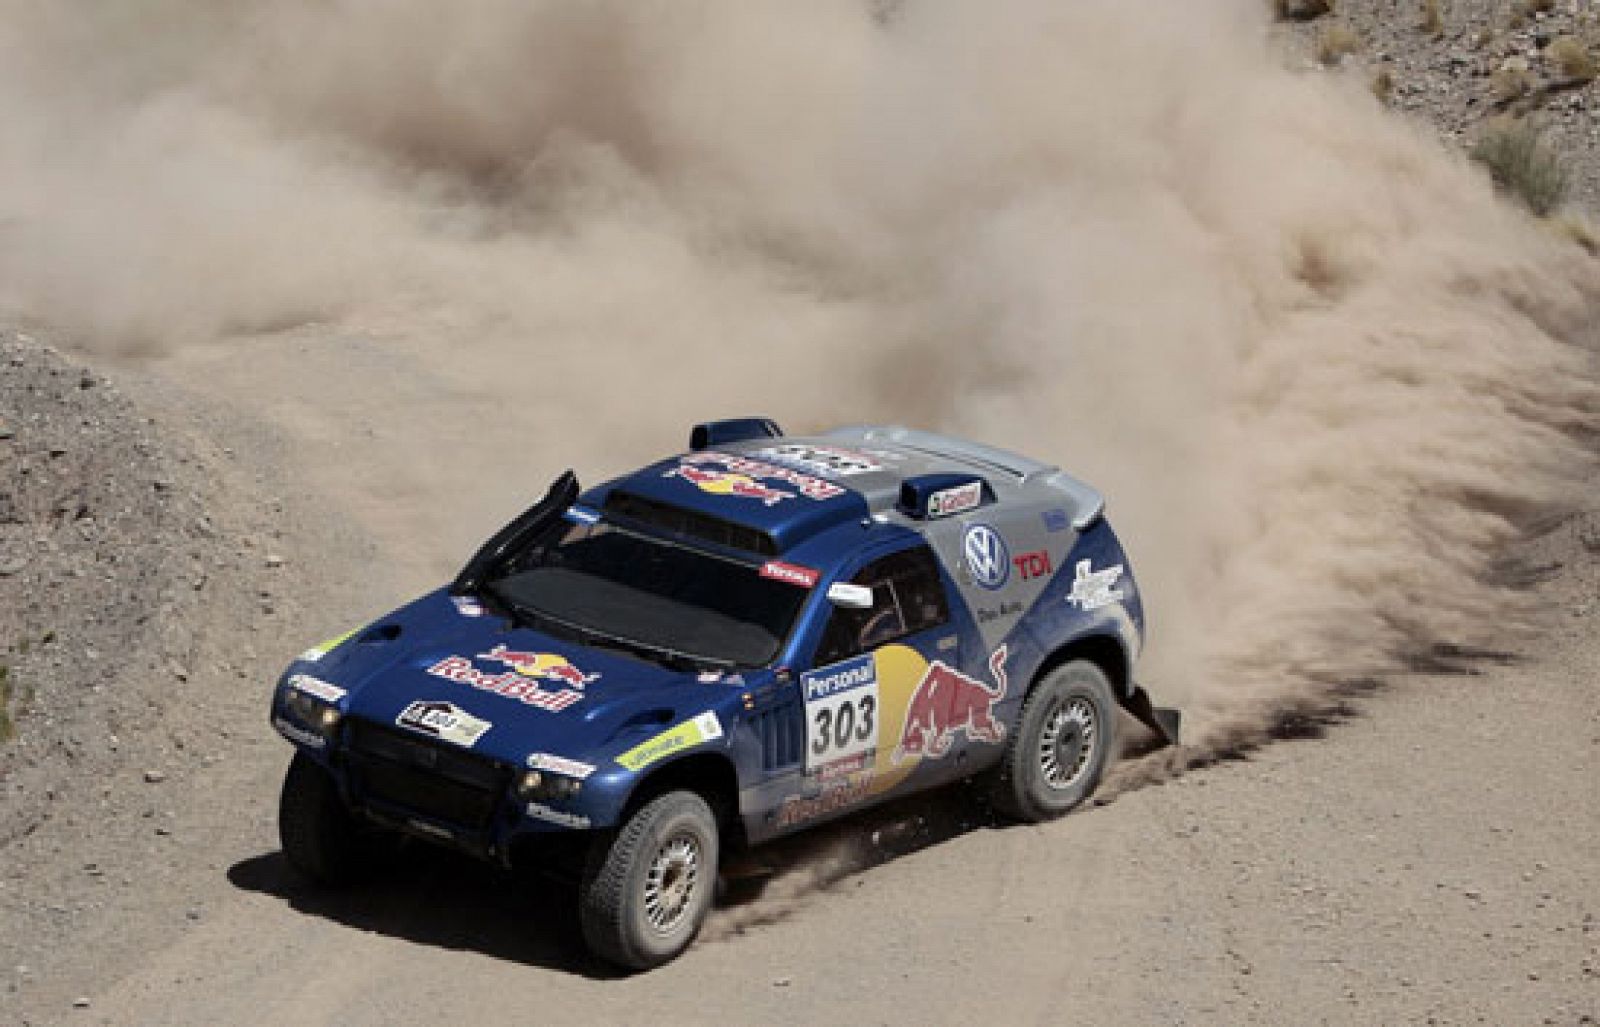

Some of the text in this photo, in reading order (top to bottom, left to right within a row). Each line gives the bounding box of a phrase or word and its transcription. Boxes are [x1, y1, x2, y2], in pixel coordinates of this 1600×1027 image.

[1012, 549, 1052, 580] TDI
[808, 658, 874, 697] Personal
[811, 694, 876, 754] 303
